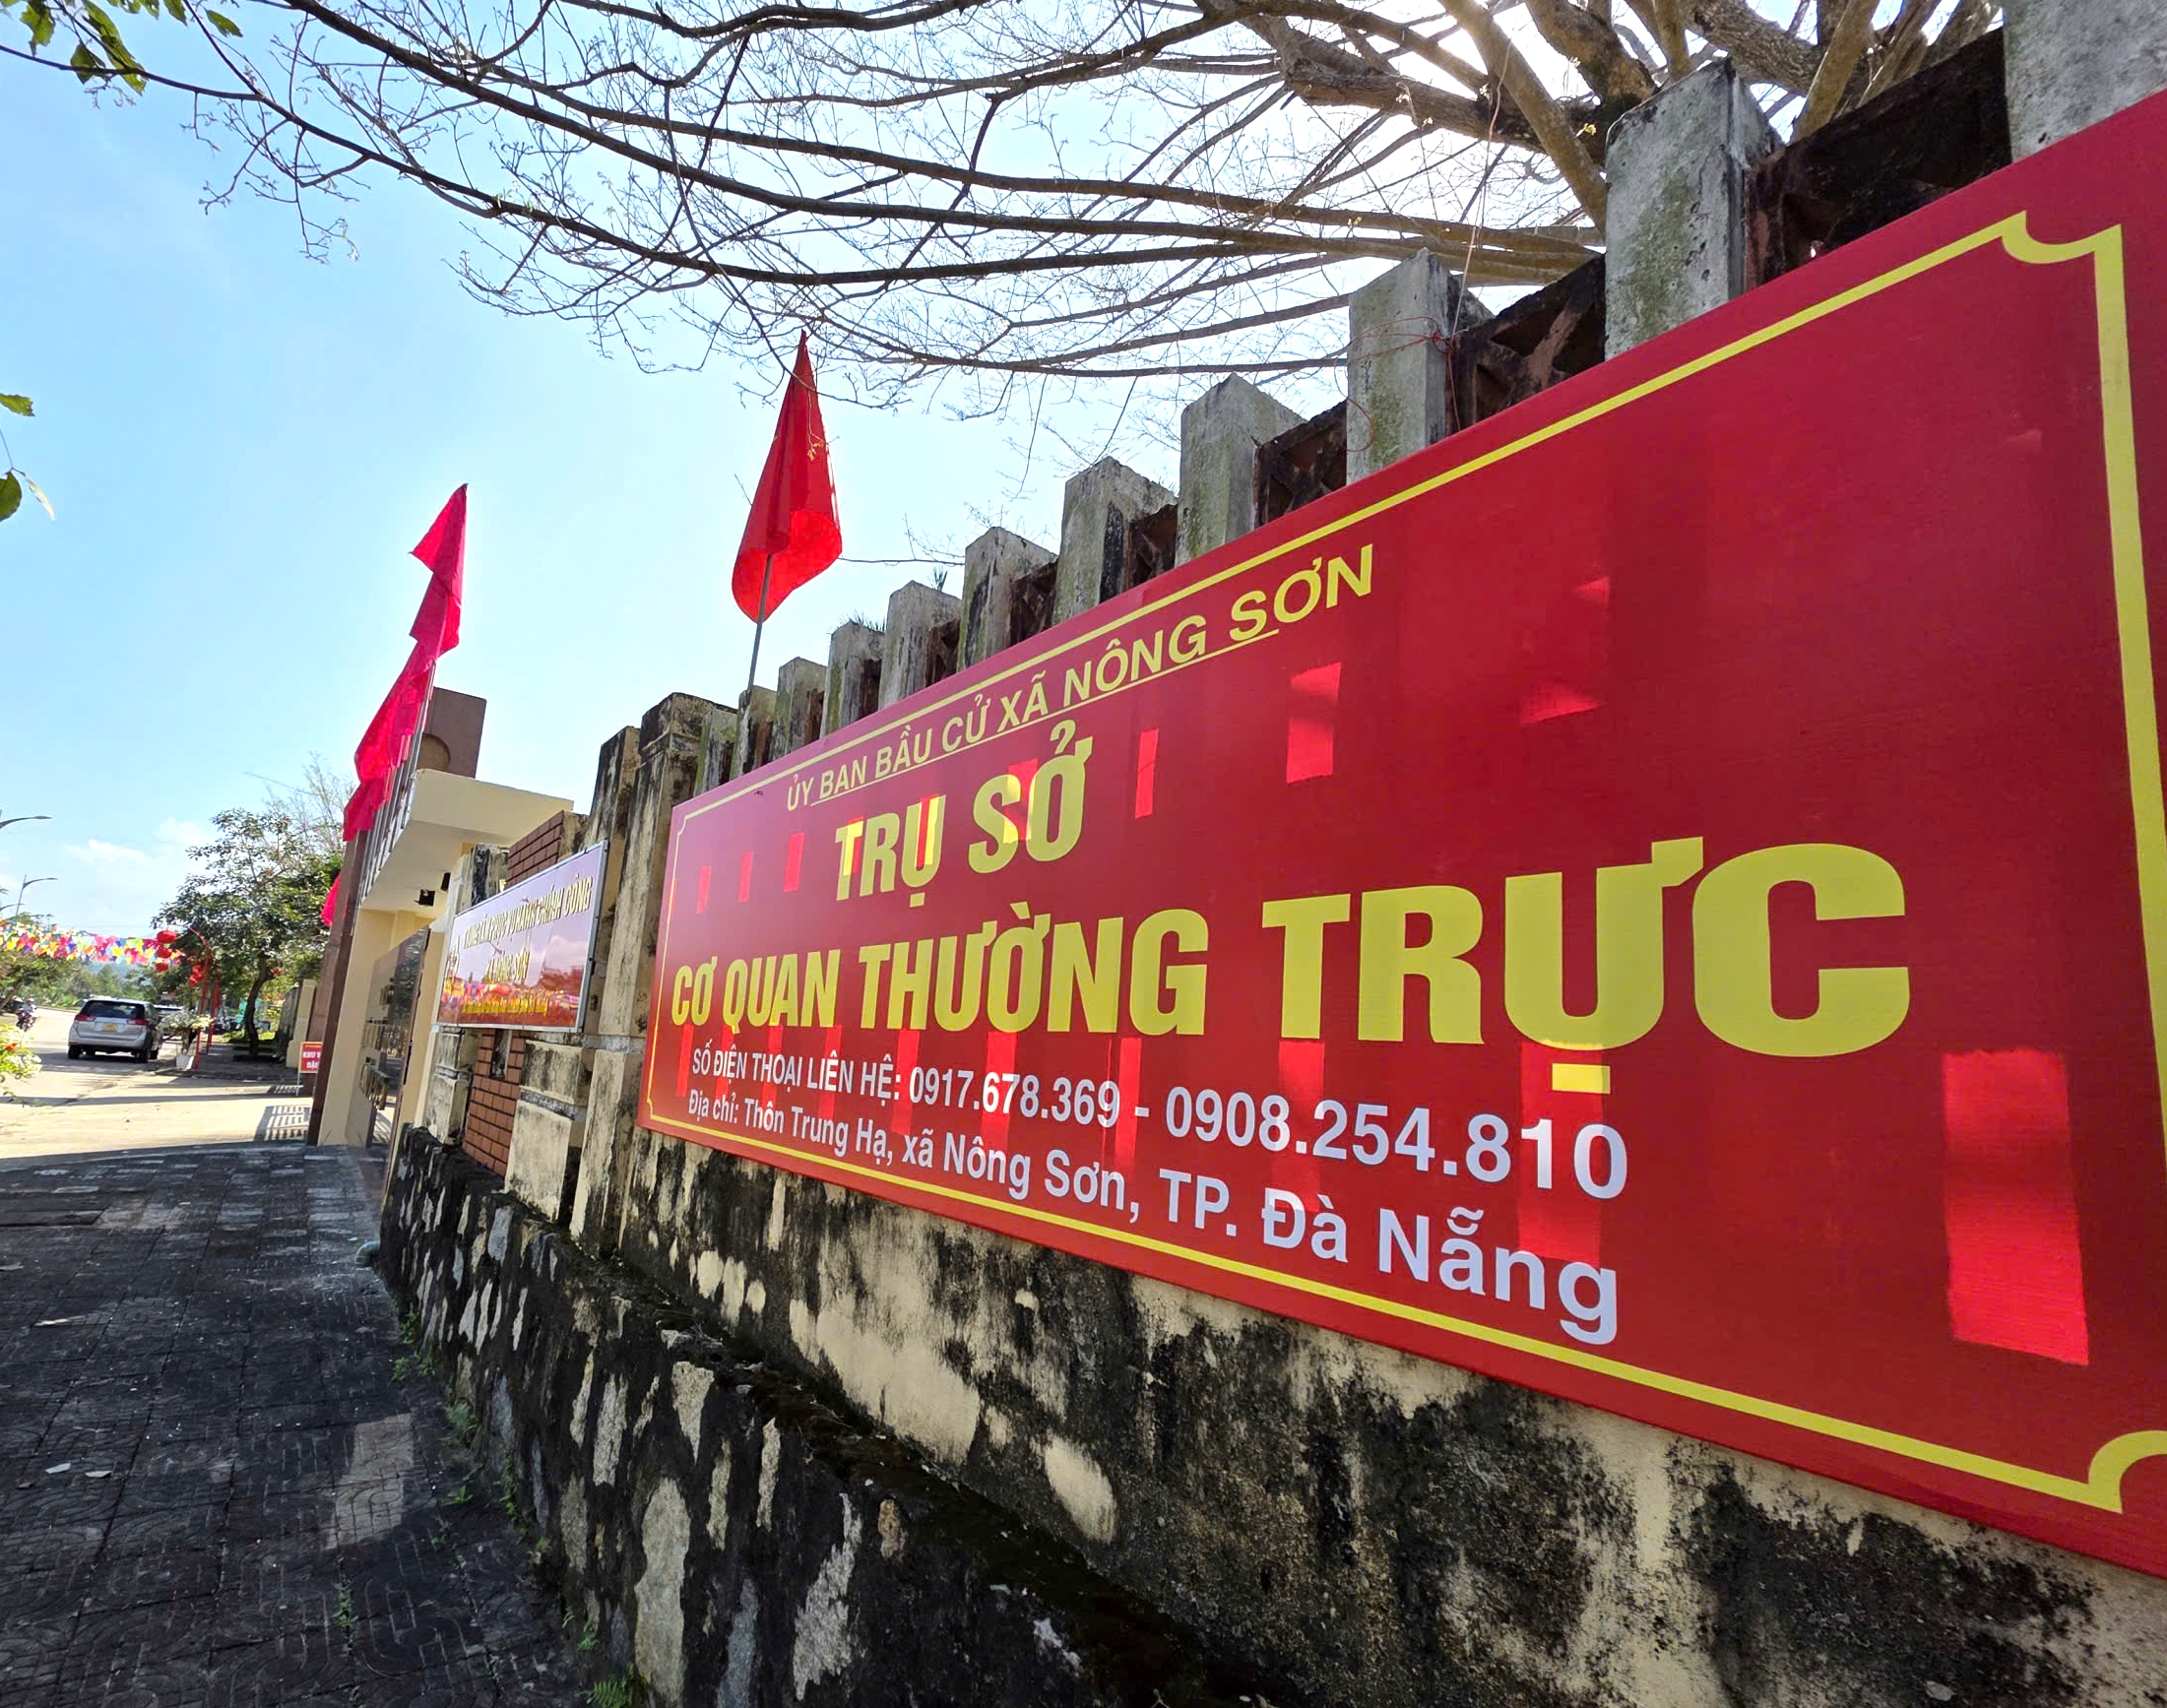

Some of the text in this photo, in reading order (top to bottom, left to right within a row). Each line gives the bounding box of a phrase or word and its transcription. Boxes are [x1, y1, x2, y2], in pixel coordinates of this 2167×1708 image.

[787, 543, 1372, 811] ỦY BAN BẦU CỬ XÃ NÔNG SƠN
[835, 720, 1092, 907] TRỤ SỞ
[671, 836, 1910, 1094] CƠ QUAN THƯỜNG TRỰC
[688, 1089, 1618, 1345] Địa chỉ: Thôn Trung Hạ, xã Nông Sơn, TP. Đà Nẵng
[692, 1039, 1628, 1199] SỐ ĐIỆN THOẠI LIÊN HỆ: 0917.678.369 - 0908.254.810
